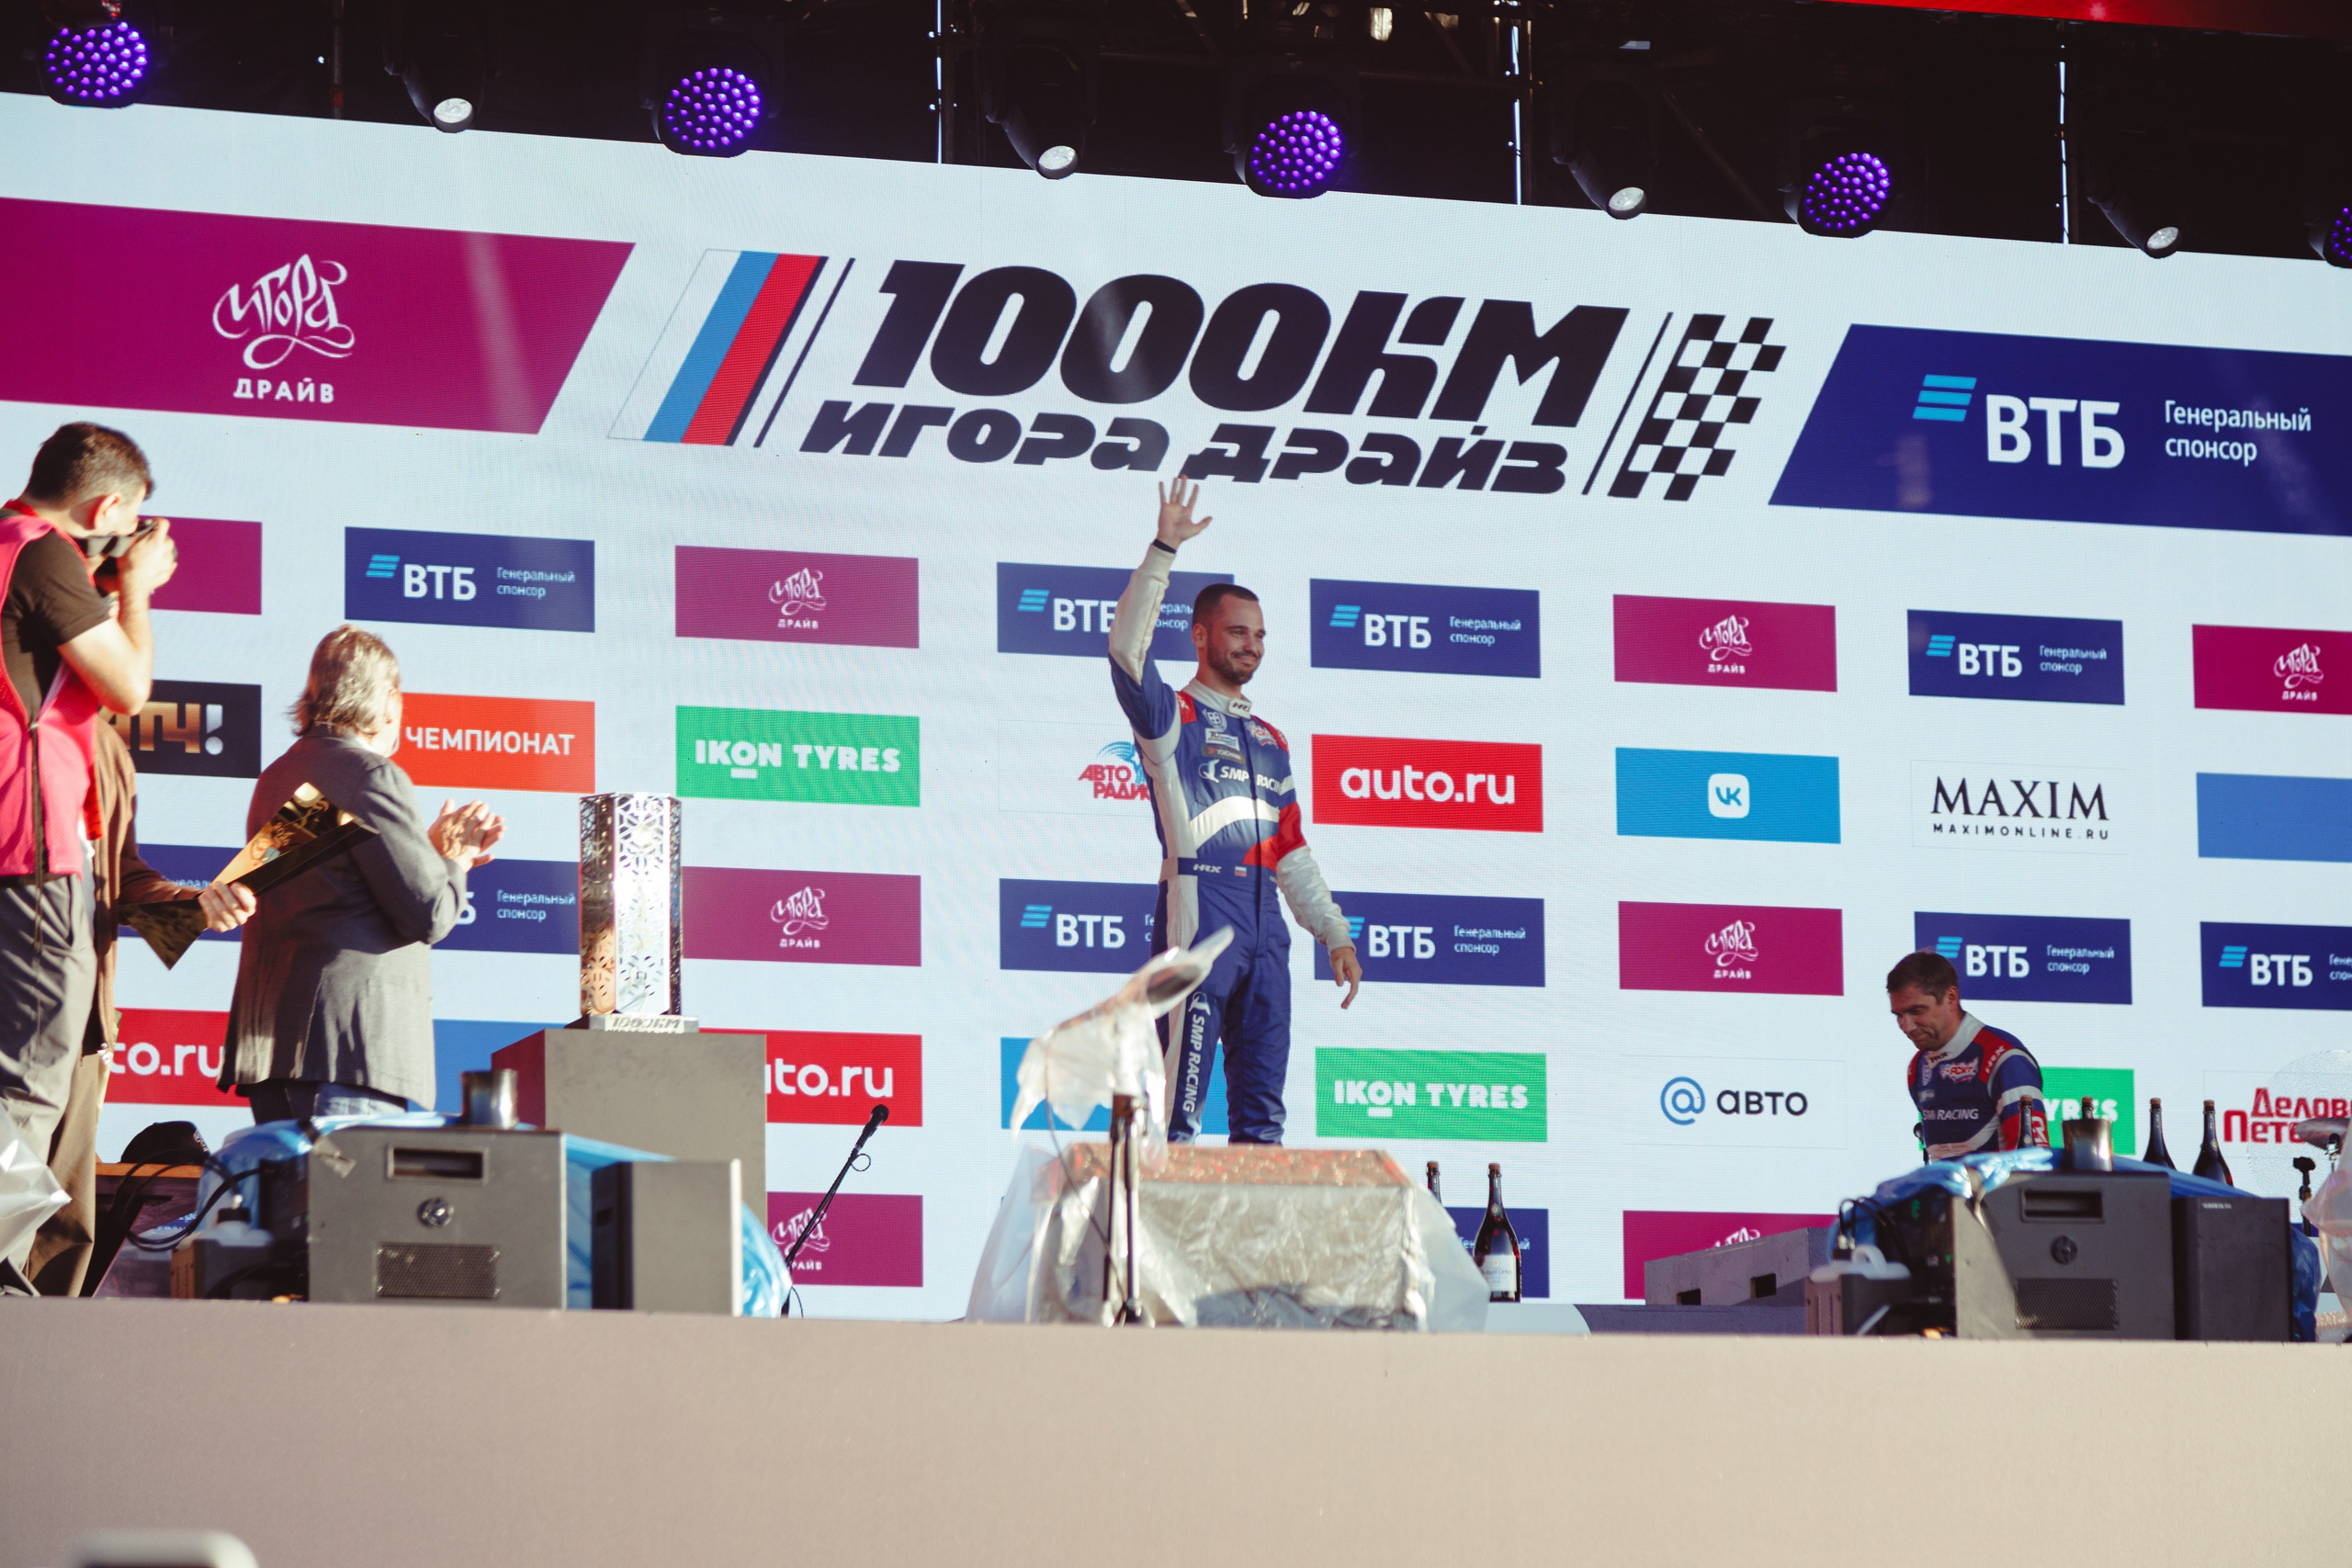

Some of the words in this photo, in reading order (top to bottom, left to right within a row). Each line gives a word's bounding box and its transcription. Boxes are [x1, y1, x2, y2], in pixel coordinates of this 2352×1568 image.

[852, 259, 1631, 428] 1000КМ
[233, 377, 334, 403] ДРАЙВ
[2165, 400, 2312, 433] Генеральный
[1986, 393, 2125, 469] ВТБ
[798, 399, 1170, 472] ИГОРА
[1177, 422, 1569, 494] ДРАЙВ
[2165, 436, 2257, 467] спонсор
[403, 563, 477, 601] ВТБ
[497, 566, 575, 583] Генеральный
[496, 584, 546, 600] спонсор
[777, 617, 819, 629] ДРАЙВ
[1154, 617, 1188, 632] онсор
[1364, 613, 1431, 649] ВТБ
[1449, 616, 1521, 631] Генеральный
[1450, 633, 1496, 647] спонсор
[1959, 643, 2023, 678] ВТБ
[2039, 645, 2108, 660] Генеральный
[1708, 662, 1746, 674] ДРАЙВ
[2040, 660, 2083, 675] спонсор
[2281, 689, 2318, 702] ДРАЙВ
[405, 726, 575, 756] ЧЕМПИОНАТ
[695, 739, 782, 770] IKON
[793, 744, 901, 773] TYRES
[1078, 763, 1132, 783] АВТО
[1220, 766, 1250, 782] SMP
[1093, 782, 1151, 801] РАДИ
[1340, 764, 1515, 805] auto.ru
[1714, 785, 1744, 807] VK
[1930, 775, 2110, 821] MAXIM
[1933, 823, 2109, 840] MAXIMONLINE.RU
[497, 889, 577, 907] Генеральный
[497, 908, 547, 922] спонсор
[1057, 913, 1125, 949] ВТБ
[1368, 924, 1436, 959] ВТБ
[1453, 924, 1526, 940] Генеральный
[779, 937, 821, 949] ДРАЙВ
[1453, 942, 1500, 956] спонсор
[2046, 944, 2115, 959] Генеральный
[1965, 944, 2030, 978] ВТБ
[2047, 962, 2090, 975] спонсор
[2251, 953, 2313, 987] ВТБ
[1713, 967, 1752, 979] ДРАЙВ
[1189, 1013, 1205, 1055] SMP
[764, 1057, 893, 1098] to.ru
[1182, 1051, 1202, 1113] RACING
[1334, 1080, 1417, 1106] IKON
[1426, 1082, 1529, 1109] TYRES
[1716, 1089, 1808, 1116] авто
[2250, 1088, 2352, 1120] Делов
[1937, 1108, 1980, 1121] RACING
[790, 1259, 822, 1270] РАЙВ
